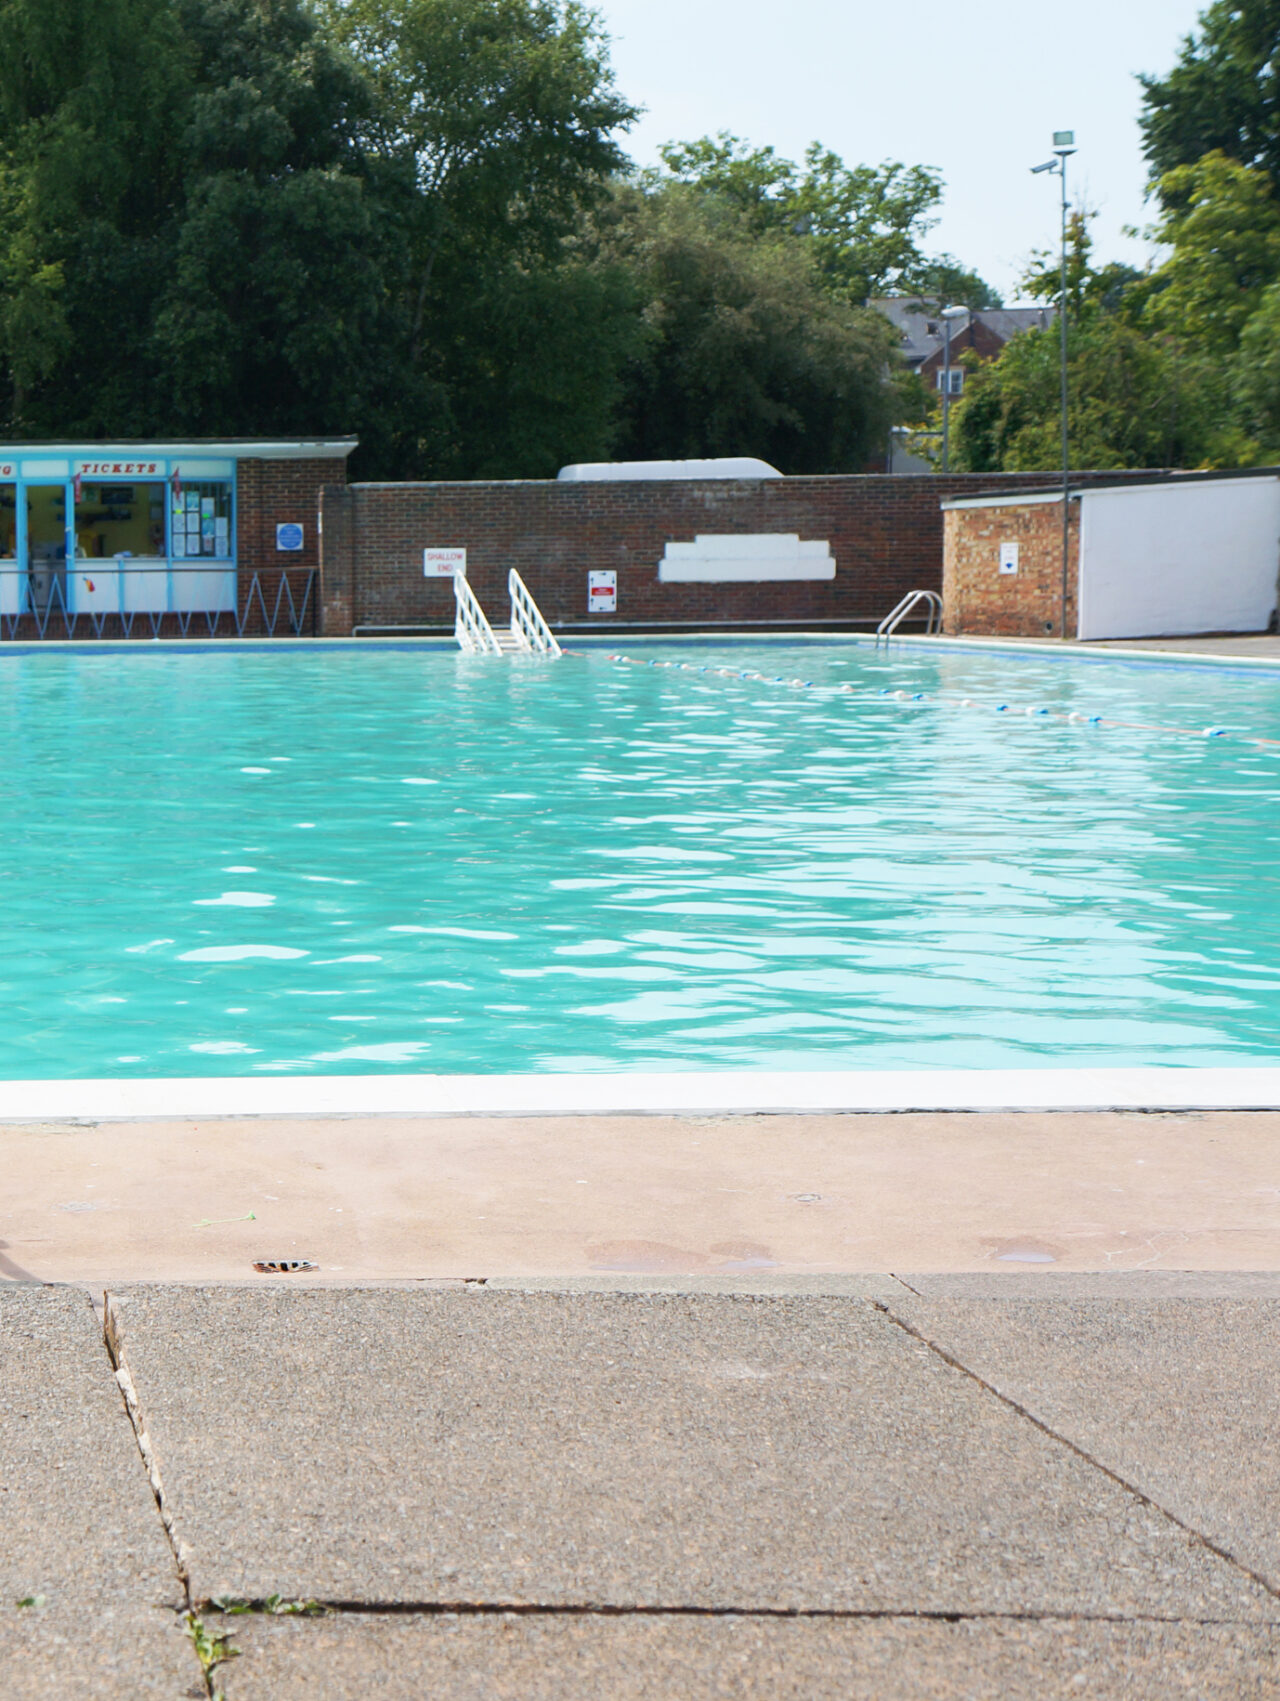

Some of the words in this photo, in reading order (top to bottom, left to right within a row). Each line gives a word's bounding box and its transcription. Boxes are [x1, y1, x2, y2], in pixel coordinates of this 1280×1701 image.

[81, 463, 157, 474] TICKETS
[427, 552, 462, 560] SHALLOW
[437, 563, 453, 571] END
